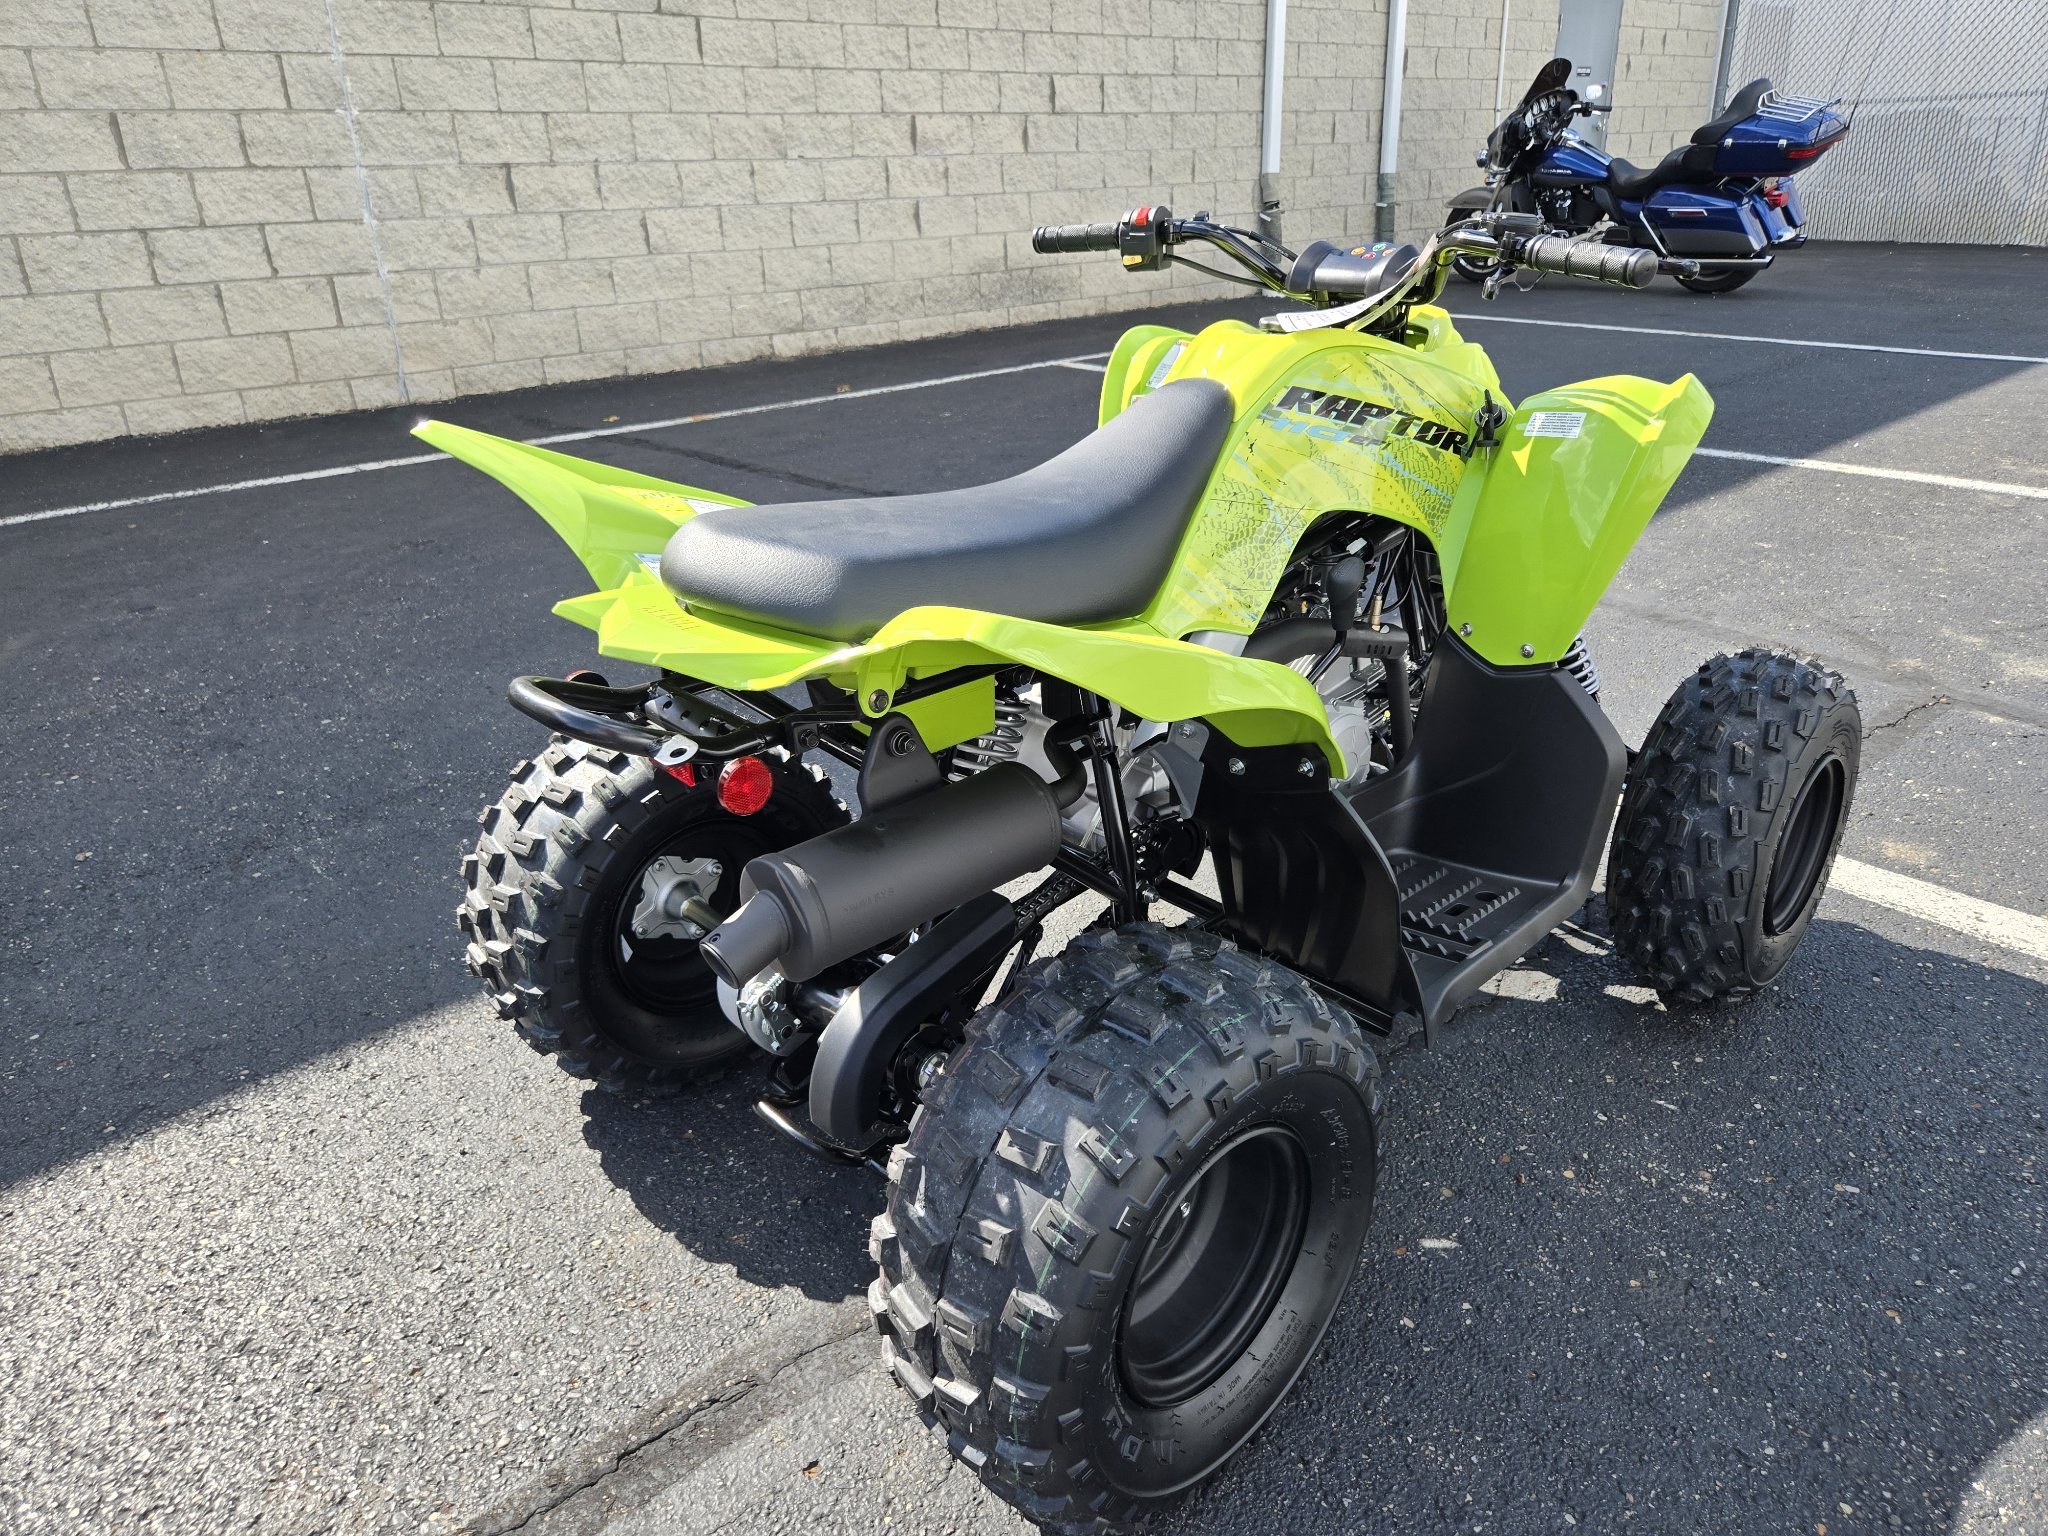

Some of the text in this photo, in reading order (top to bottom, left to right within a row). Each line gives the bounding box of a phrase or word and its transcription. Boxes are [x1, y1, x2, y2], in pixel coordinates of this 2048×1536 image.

[1271, 418, 1351, 442] 110
[1275, 386, 1469, 457] RAPTOR
[1227, 1374, 1242, 1392] MADE
[1218, 1391, 1227, 1400] IN
